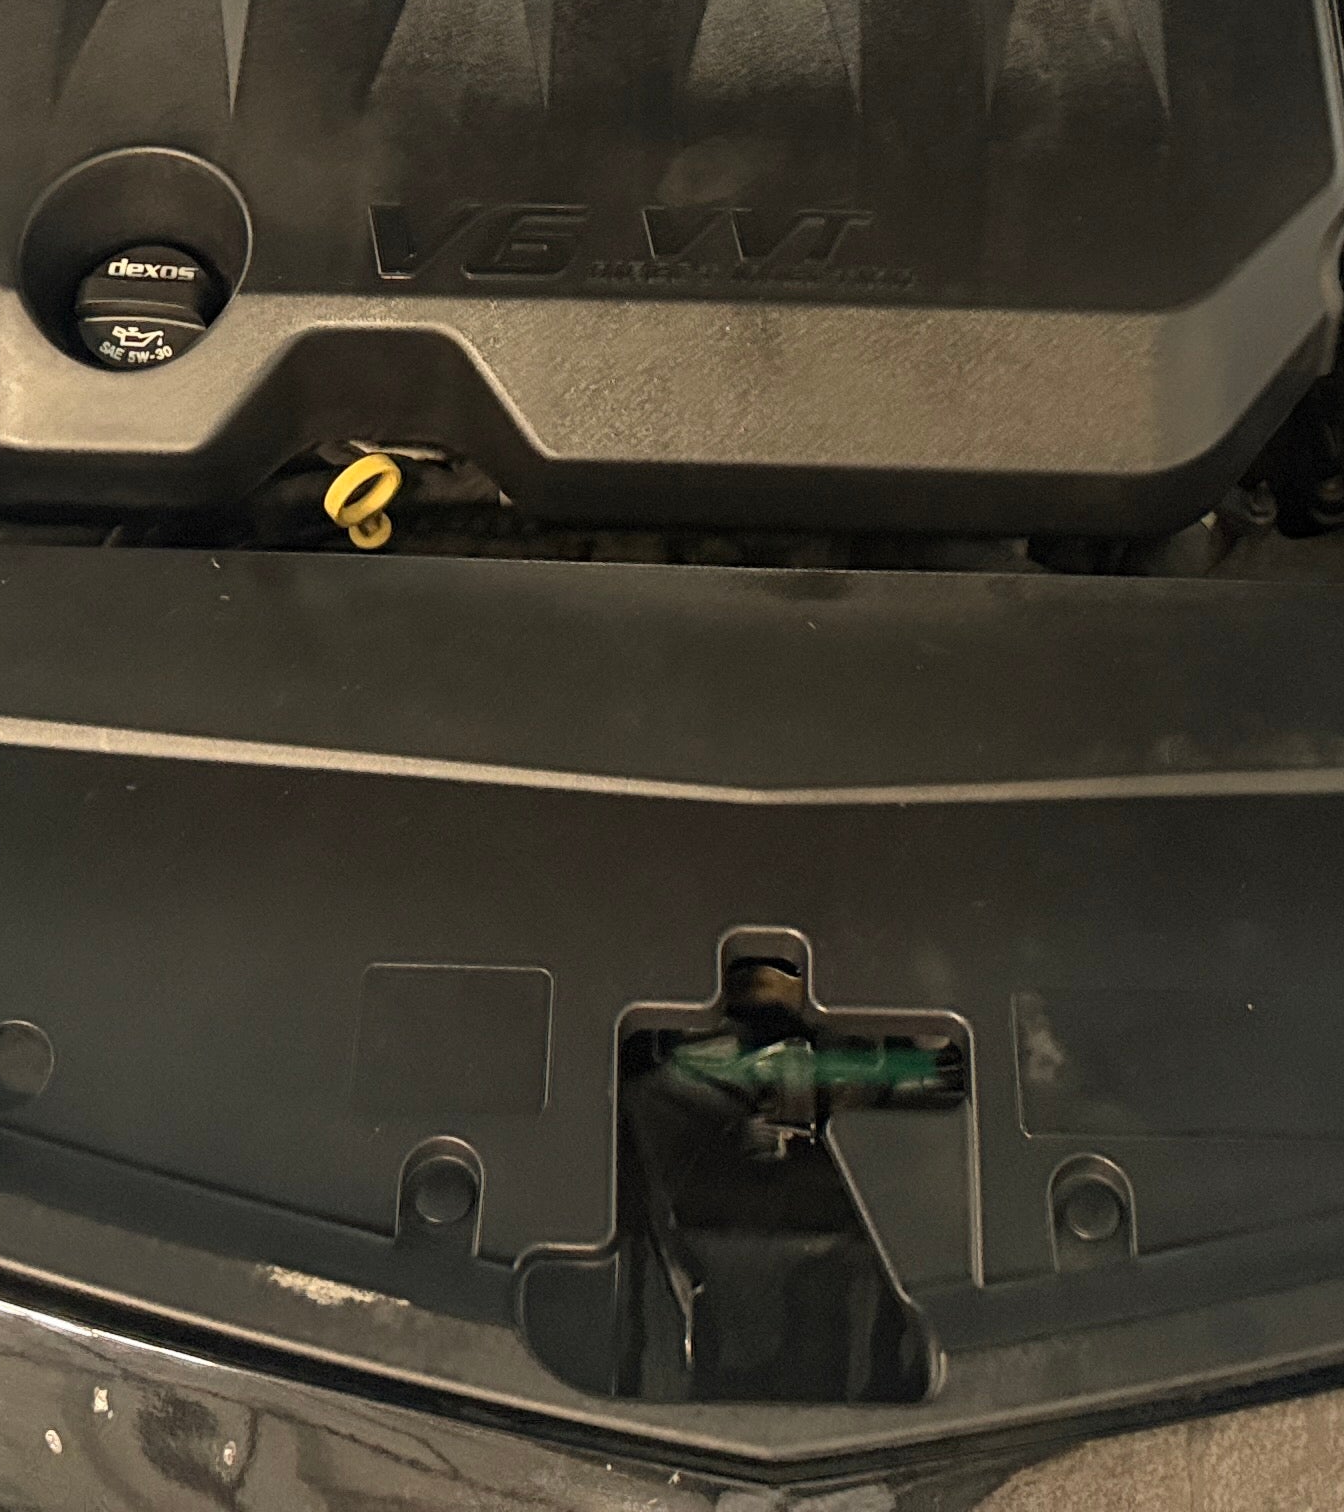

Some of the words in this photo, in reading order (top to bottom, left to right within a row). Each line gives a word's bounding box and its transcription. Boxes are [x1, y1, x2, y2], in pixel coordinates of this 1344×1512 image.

[368, 203, 589, 280] V6
[642, 205, 876, 264] VVT
[107, 257, 199, 281] dexos
[99, 341, 126, 361] SAE
[127, 345, 174, 363] 5W-30
